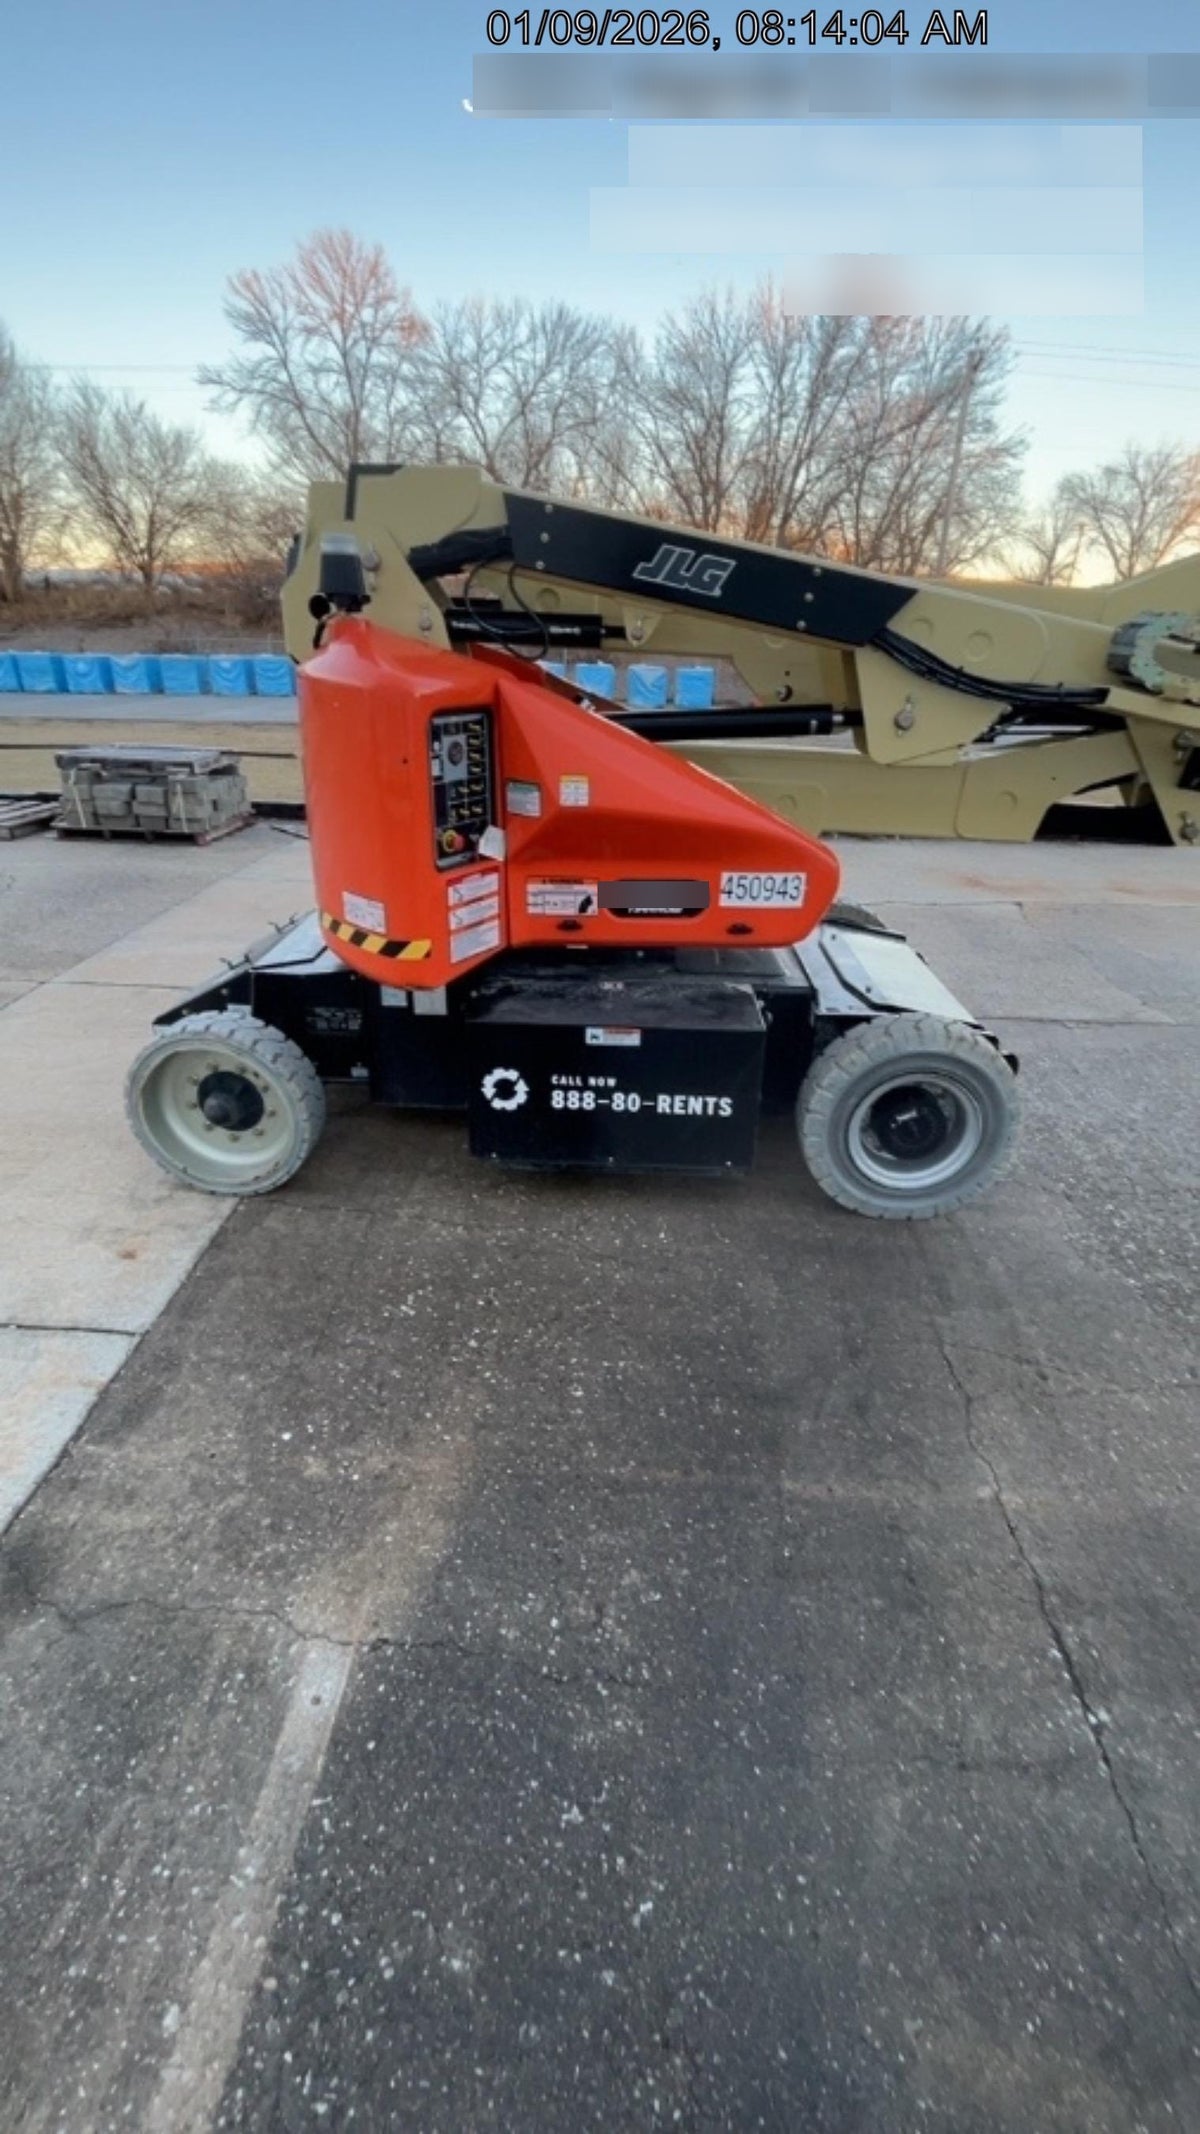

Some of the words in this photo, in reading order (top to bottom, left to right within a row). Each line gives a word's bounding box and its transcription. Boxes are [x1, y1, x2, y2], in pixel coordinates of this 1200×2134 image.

[632, 543, 737, 597] JLG
[721, 875, 802, 901] 450943
[551, 1074, 583, 1087] CALL
[587, 1076, 617, 1088] NOW
[551, 1089, 733, 1117] 888-80-RENTS
